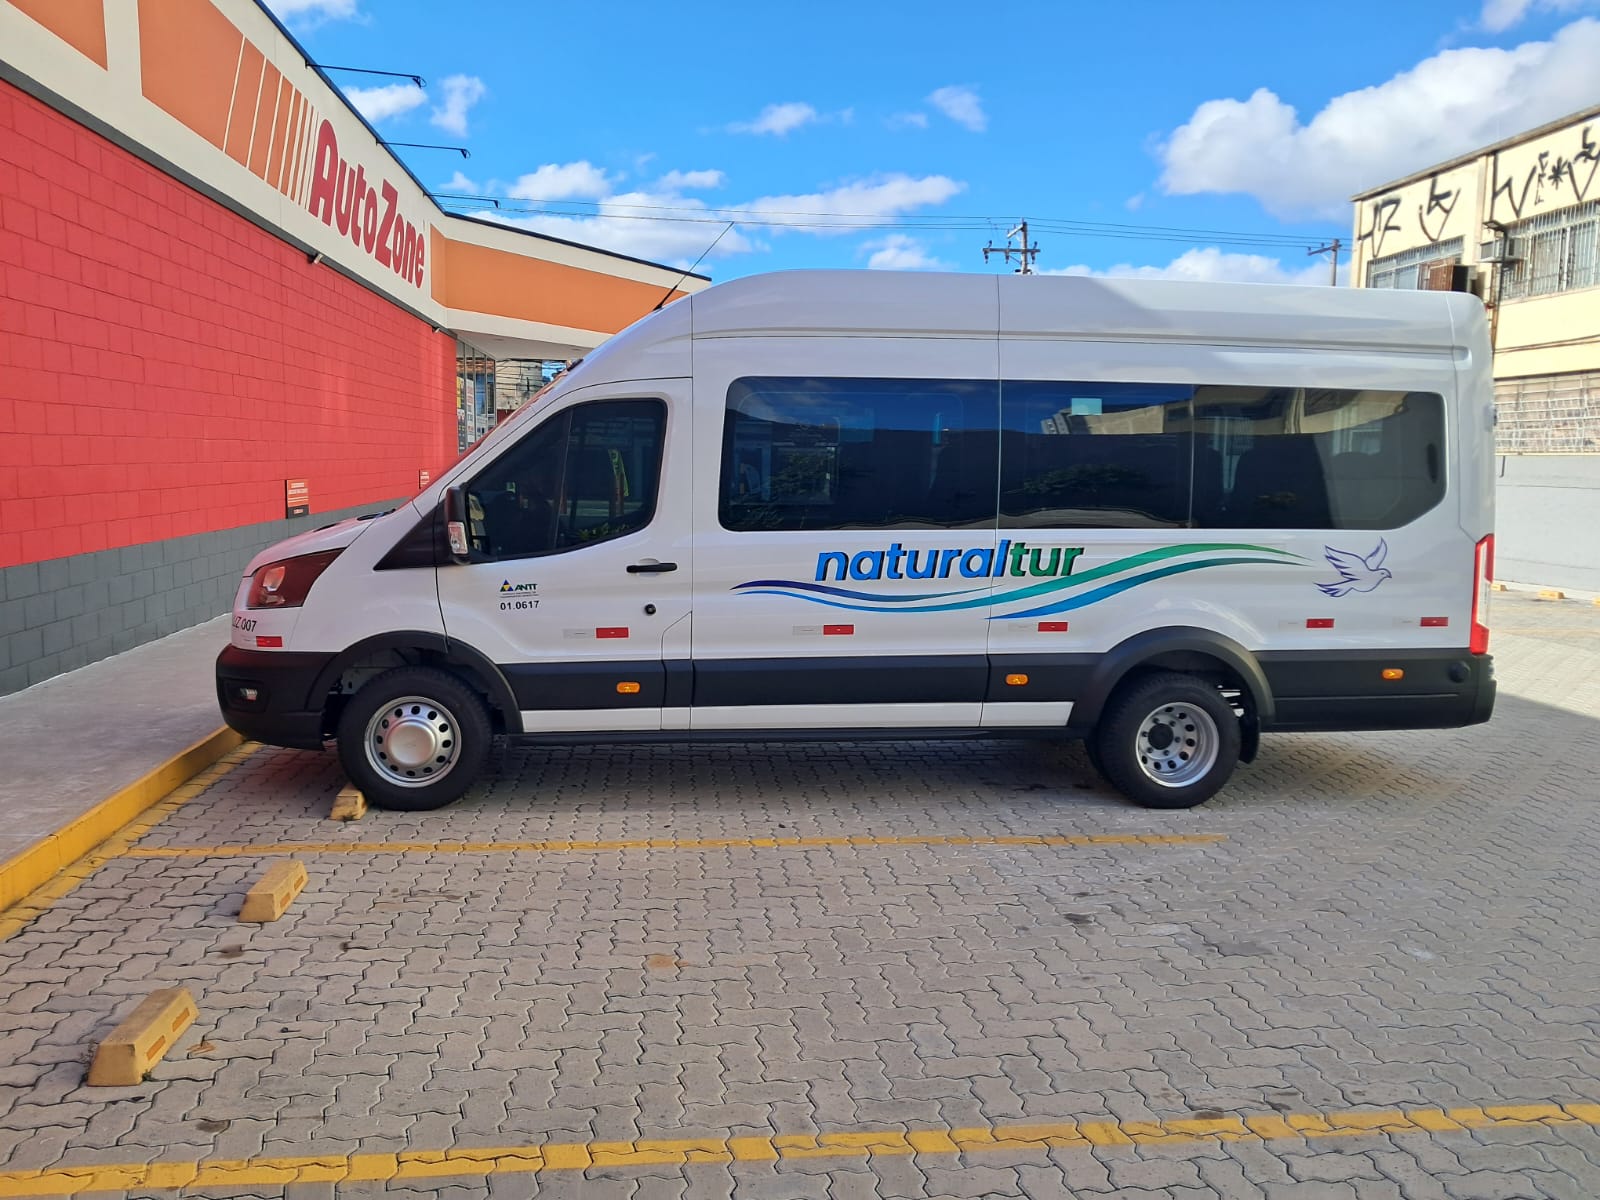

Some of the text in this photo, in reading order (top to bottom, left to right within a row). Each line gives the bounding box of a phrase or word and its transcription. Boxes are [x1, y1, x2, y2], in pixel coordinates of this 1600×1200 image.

[308, 118, 425, 289] AutoZone
[814, 539, 1085, 582] naturaltur
[514, 583, 538, 591] ANTT
[500, 600, 539, 610] 01.0617
